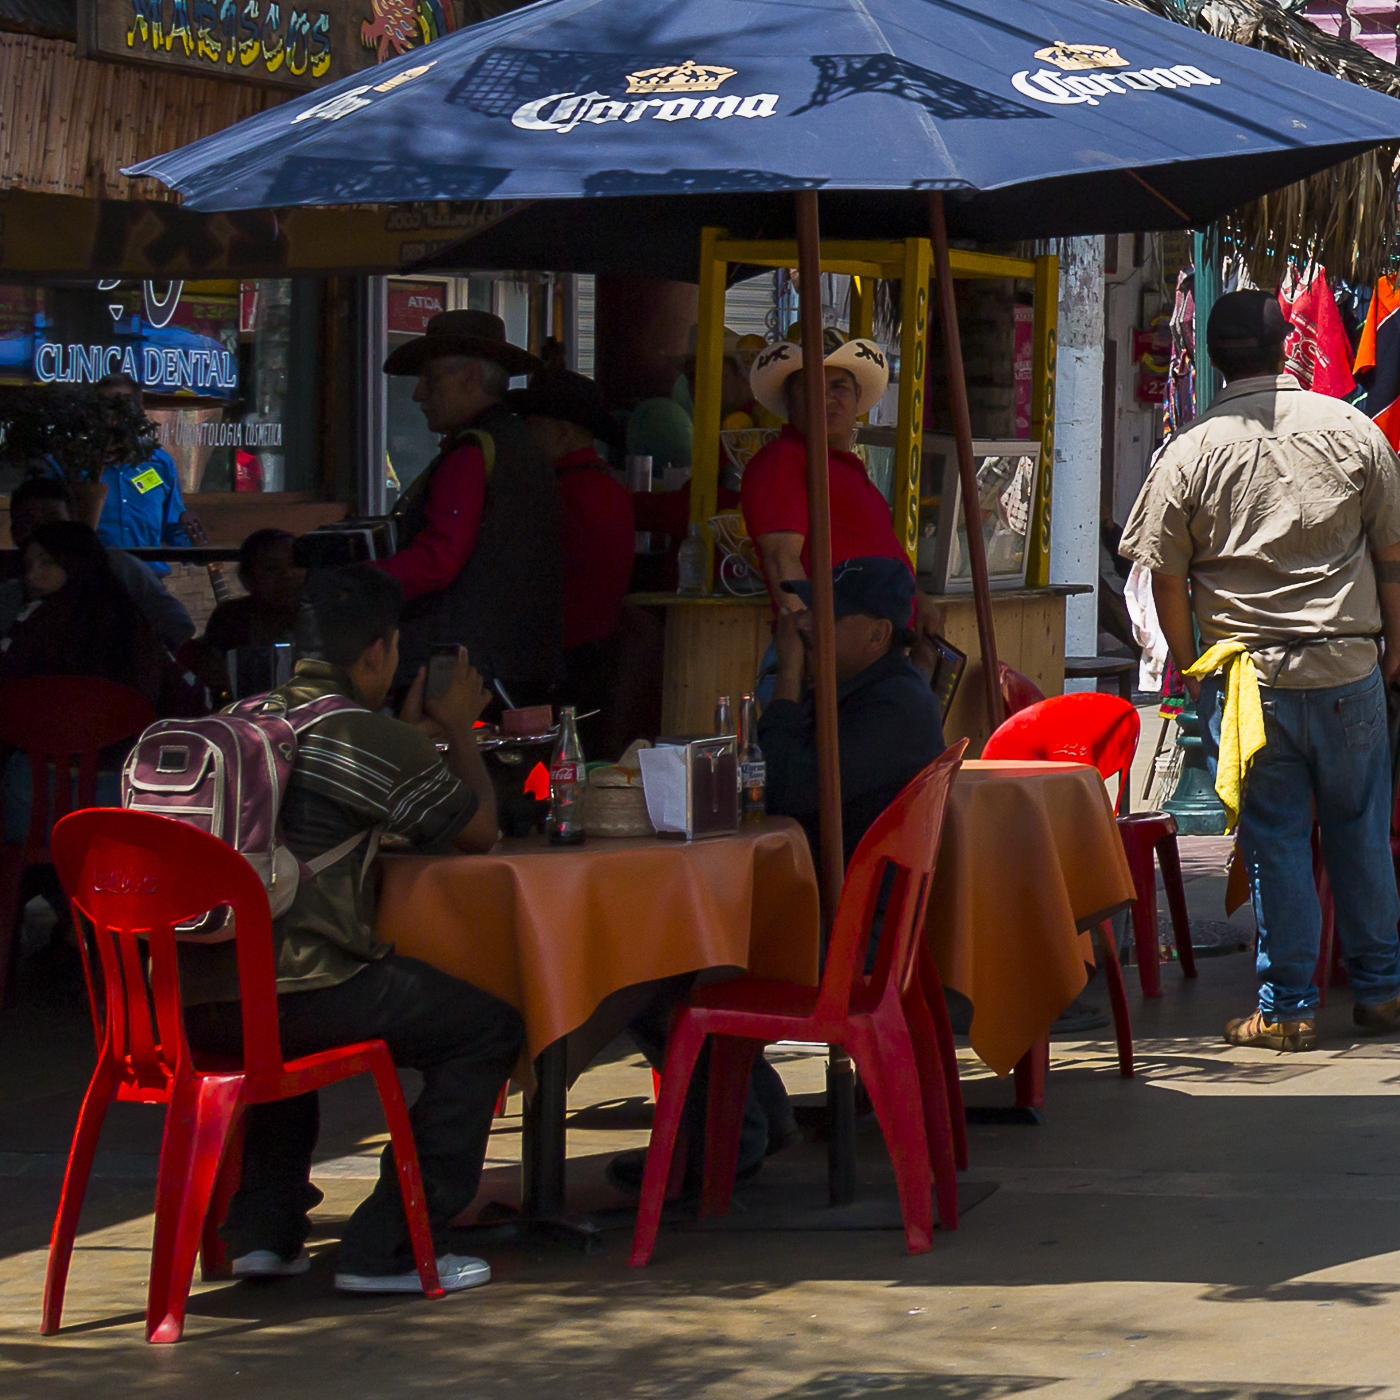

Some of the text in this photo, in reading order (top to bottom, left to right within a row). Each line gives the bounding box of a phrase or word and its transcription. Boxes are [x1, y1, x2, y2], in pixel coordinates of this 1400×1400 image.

[1011, 64, 1221, 106] Corona
[511, 90, 780, 134] Corona
[35, 344, 236, 388] CLINICA DENTAL
